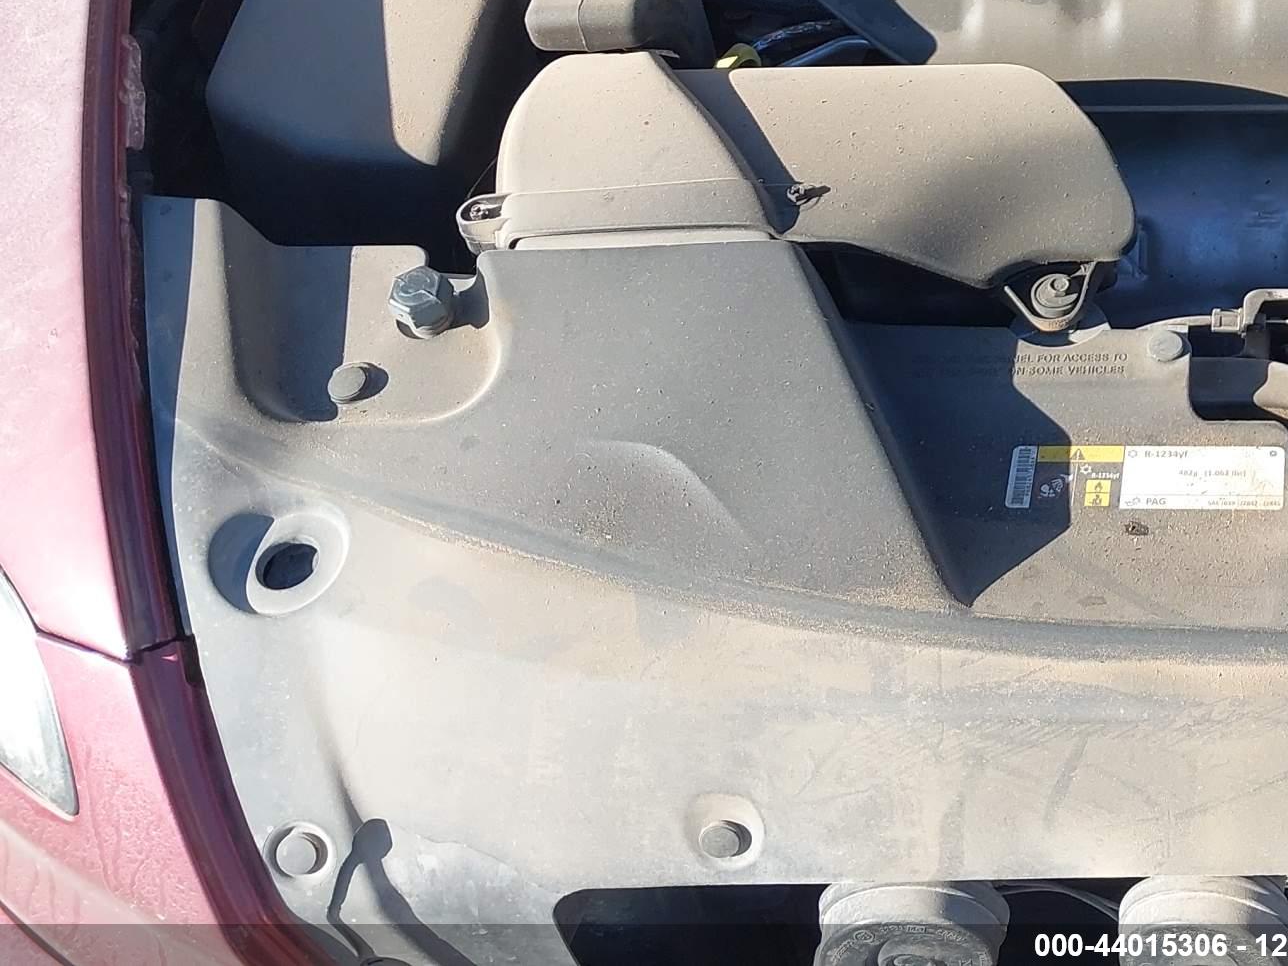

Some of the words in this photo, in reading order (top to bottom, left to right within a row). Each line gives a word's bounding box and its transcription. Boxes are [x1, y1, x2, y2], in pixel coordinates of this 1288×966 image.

[1037, 353, 1061, 363] FOR
[1063, 353, 1110, 363] ACCESS
[1113, 353, 1128, 363] TO
[1028, 365, 1064, 376] SOME
[1067, 365, 1125, 376] VEHICLES
[1144, 449, 1189, 459] R-1234yf
[1146, 497, 1167, 505] PAG
